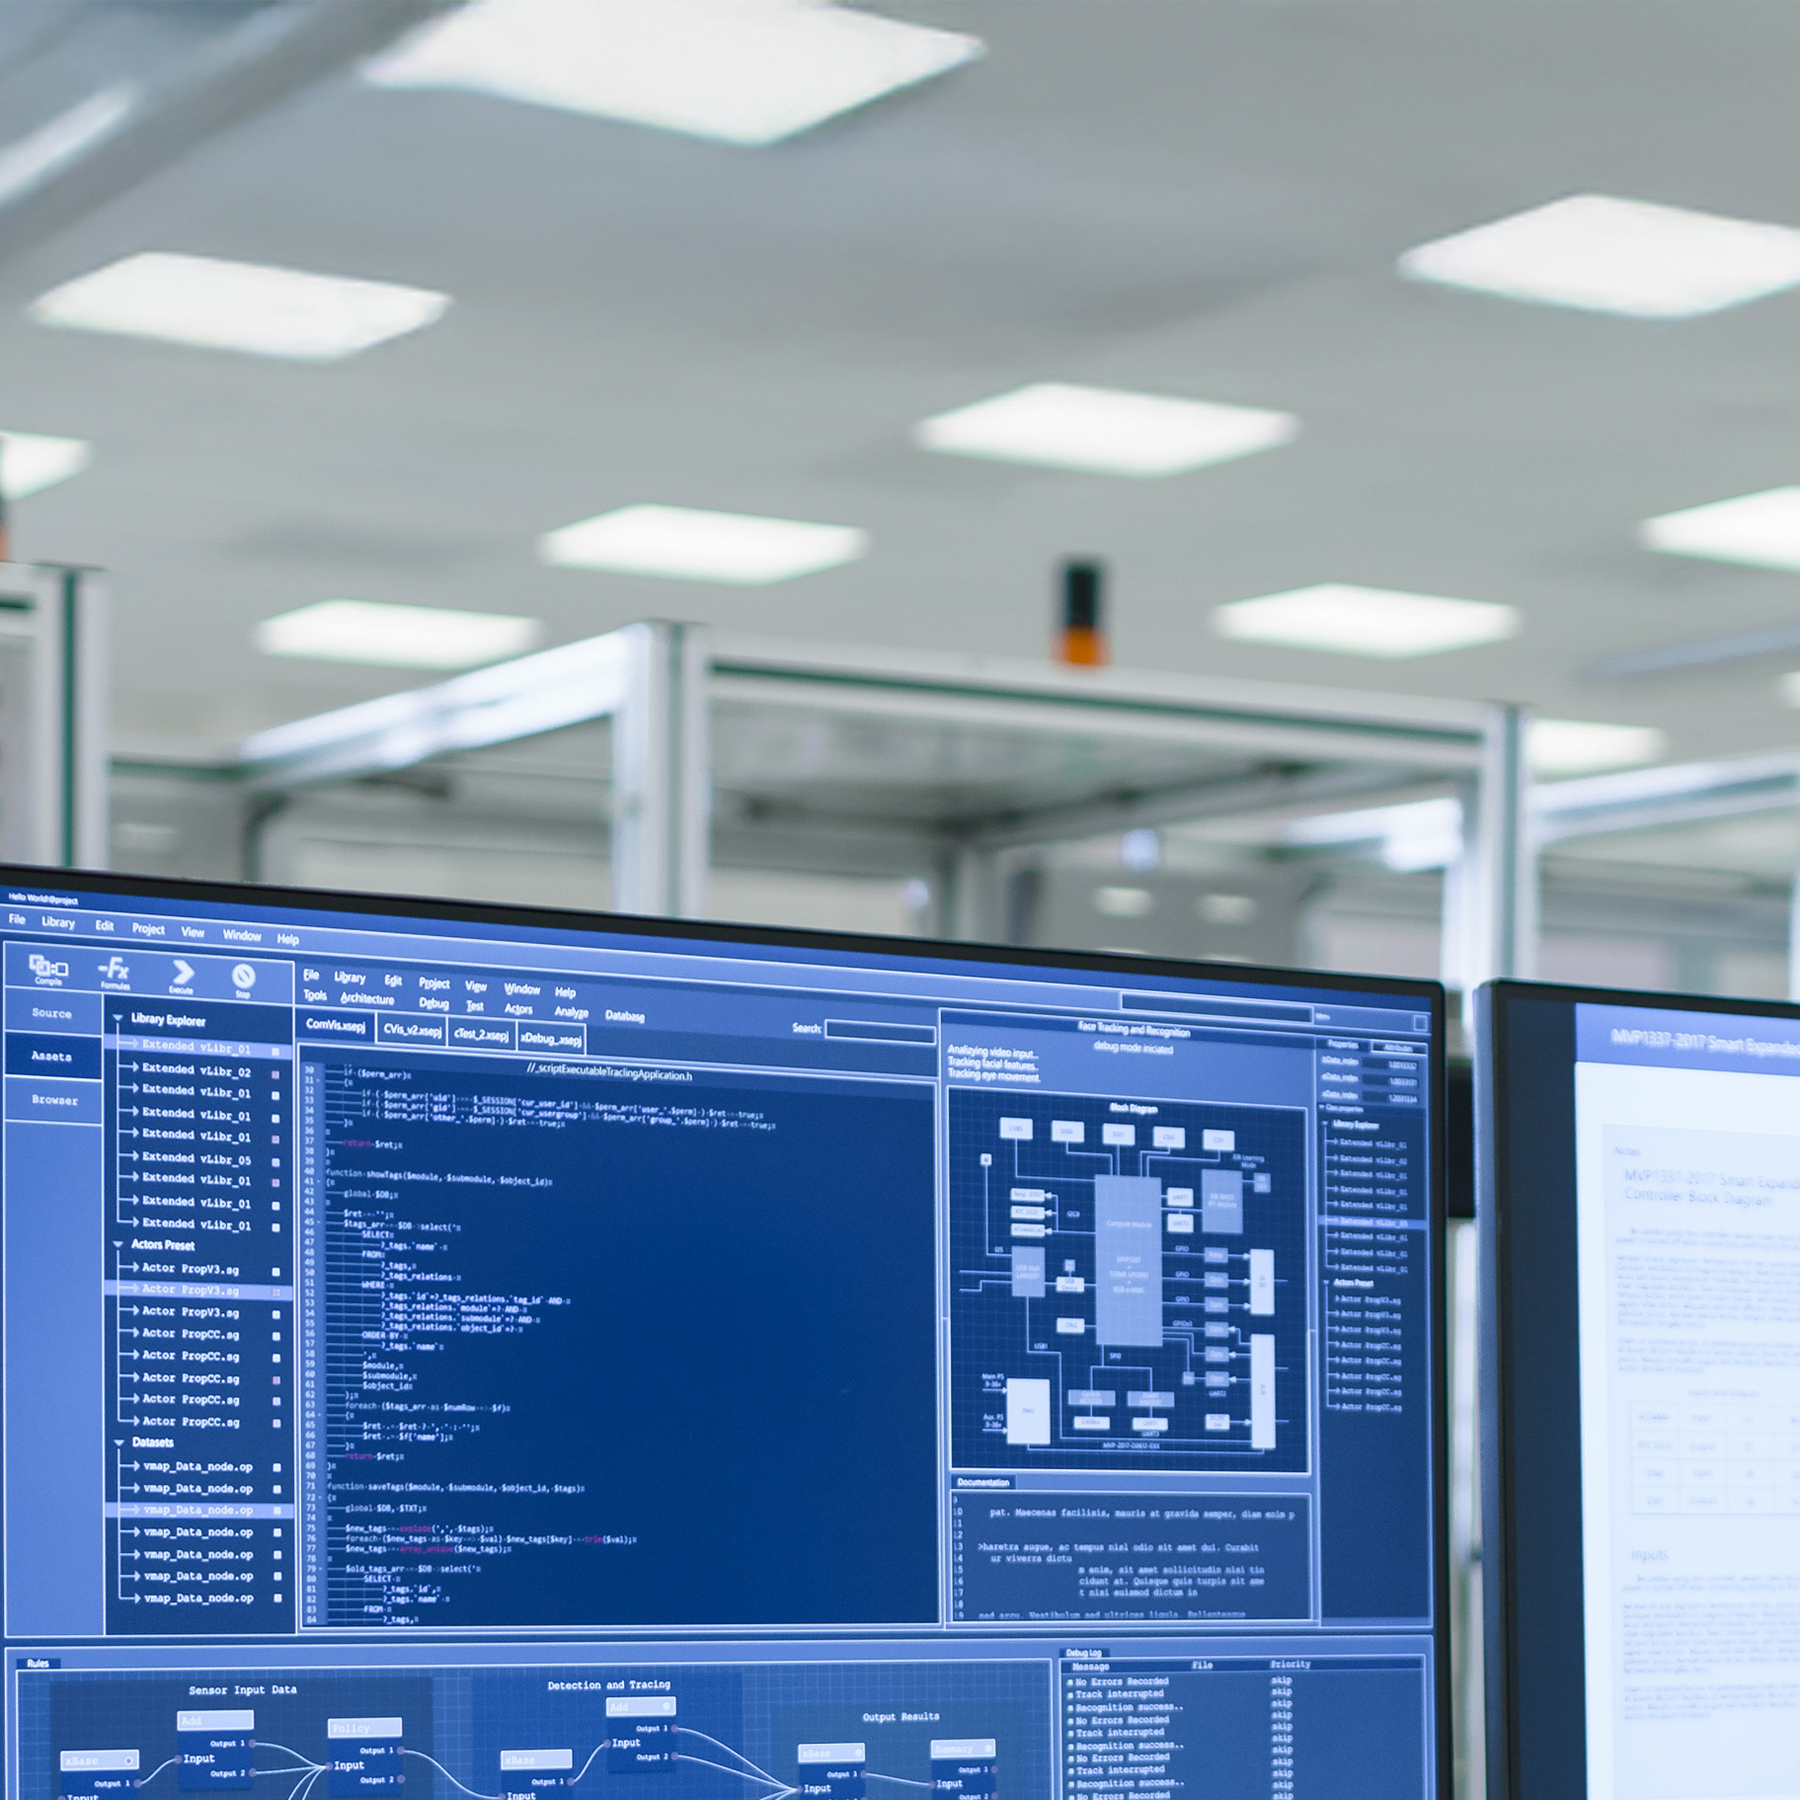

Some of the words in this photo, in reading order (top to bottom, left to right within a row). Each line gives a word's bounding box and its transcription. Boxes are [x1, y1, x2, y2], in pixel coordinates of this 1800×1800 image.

[8, 892, 27, 902] Hello
[8, 912, 27, 925] File
[41, 915, 76, 931] Library
[95, 919, 115, 932] Edit
[132, 922, 166, 937] Project
[181, 925, 205, 938] View
[222, 928, 262, 942] Window
[276, 933, 300, 947] Help
[34, 976, 63, 987] Compile
[101, 982, 130, 990] Formulas
[303, 968, 320, 982] File
[334, 970, 367, 986] Library
[384, 974, 403, 988] Edit
[418, 976, 451, 991] Project
[465, 980, 488, 994] View
[504, 982, 541, 996] Window
[554, 986, 577, 1000] Help
[168, 985, 194, 996] Execute
[235, 989, 251, 1000] Stop
[303, 988, 328, 1003] Tools
[340, 991, 395, 1006] Architecture
[418, 996, 450, 1012] Debug
[466, 999, 485, 1013] Test
[504, 1002, 534, 1016] Actors
[554, 1005, 590, 1021] Analyze
[605, 1009, 646, 1025] Database
[32, 1007, 73, 1020] Source
[131, 1012, 165, 1027] Library
[166, 1013, 207, 1028] Explorer
[792, 1022, 823, 1034] Search:
[1078, 1021, 1096, 1031] Face
[1098, 1022, 1129, 1035] Tracking
[1130, 1025, 1144, 1034] and
[1146, 1026, 1191, 1039] Recognition
[142, 1038, 195, 1052] Extended
[199, 1042, 252, 1057] vLibr_01
[1093, 1041, 1119, 1053] debug
[1121, 1042, 1142, 1052] mode
[1707, 1035, 1744, 1052] Smart
[31, 1050, 73, 1063] Assets
[990, 1047, 1012, 1056] video
[949, 1056, 981, 1069] Tracking
[982, 1058, 1002, 1068] facial
[142, 1062, 195, 1075] Extended
[199, 1065, 252, 1081] vLibr_02
[949, 1068, 981, 1081] Tracking
[982, 1070, 996, 1081] eye
[142, 1083, 195, 1096] Extended
[200, 1086, 251, 1102] vLibr_01
[31, 1094, 79, 1106] Browser
[1110, 1102, 1128, 1112] Block
[1130, 1104, 1158, 1115] Diagram
[142, 1151, 195, 1163] Extended
[200, 1154, 252, 1169] vLibr_05
[130, 1238, 164, 1250] Actors
[164, 1239, 196, 1252] Preset
[141, 1262, 176, 1273] Actor
[181, 1263, 240, 1277] PropV3.sg
[141, 1283, 176, 1295] Actor
[181, 1284, 240, 1299] PropV3.sg
[142, 1327, 176, 1339] Actor
[181, 1328, 240, 1342] PropCC.sg
[132, 1436, 175, 1448] Datasets
[143, 1461, 254, 1475] vmap_Data_node.op
[957, 1477, 1010, 1488] Documentation
[143, 1483, 254, 1496] vmap_Data_node.op
[143, 1592, 255, 1605] vmap_Data_node.op
[1067, 1649, 1088, 1657] Debug
[27, 1658, 50, 1669] Rules
[1072, 1662, 1110, 1673] Message
[1192, 1660, 1214, 1670] File
[1270, 1659, 1311, 1670] Priority
[547, 1680, 602, 1691] Detection
[606, 1679, 625, 1690] and
[629, 1679, 671, 1691] Tracing
[1076, 1678, 1087, 1686] No
[1090, 1677, 1123, 1687] Errors
[1126, 1676, 1170, 1686] Recorded
[1271, 1677, 1292, 1685] skip
[188, 1685, 228, 1696] Sensor
[234, 1685, 266, 1697] Input
[271, 1684, 298, 1695] Data
[1075, 1689, 1103, 1699] Track
[1107, 1688, 1165, 1700] interrupted
[1271, 1686, 1293, 1697] skip
[1075, 1702, 1134, 1714] Recognition
[181, 1715, 202, 1726] Add
[862, 1712, 897, 1724] Output
[900, 1711, 941, 1722] Results
[332, 1723, 371, 1735] Policy
[65, 1756, 99, 1766] xBase
[183, 1753, 216, 1766] Input
[334, 1760, 365, 1772] Input
[94, 1780, 122, 1789] Output
